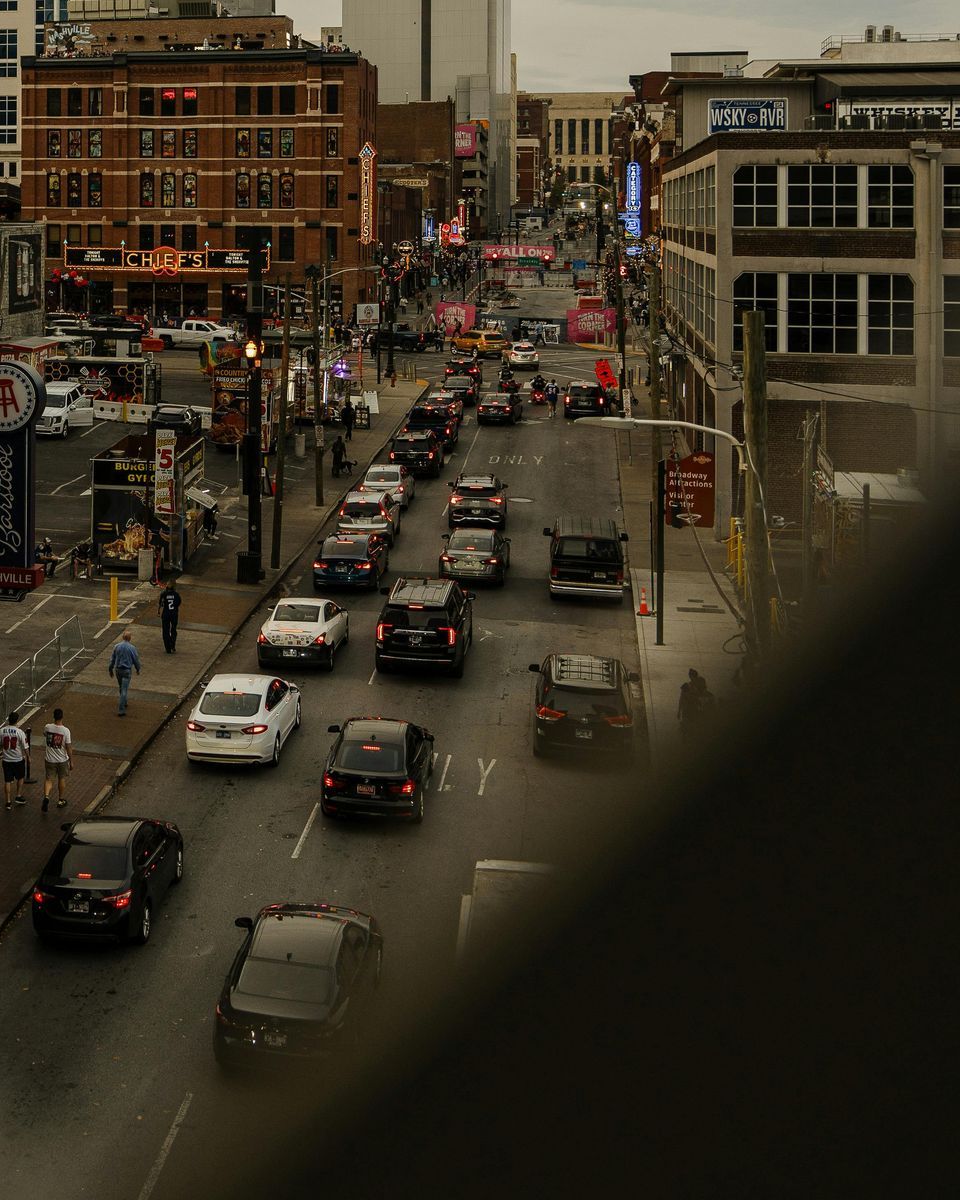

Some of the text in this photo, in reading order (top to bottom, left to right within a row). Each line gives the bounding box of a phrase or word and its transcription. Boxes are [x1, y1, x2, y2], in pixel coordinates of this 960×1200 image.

[48, 25, 90, 44] NASHVILLE
[853, 107, 949, 117] WHISKEY
[711, 109, 784, 126] WSKY RVR
[455, 140, 472, 148] RNER
[497, 247, 526, 257] Y'ALL
[528, 248, 542, 257] ON
[127, 253, 203, 267] CHIEF'S
[488, 455, 544, 465] ONLY
[669, 471, 707, 480] Broadway
[167, 599, 175, 610] 2
